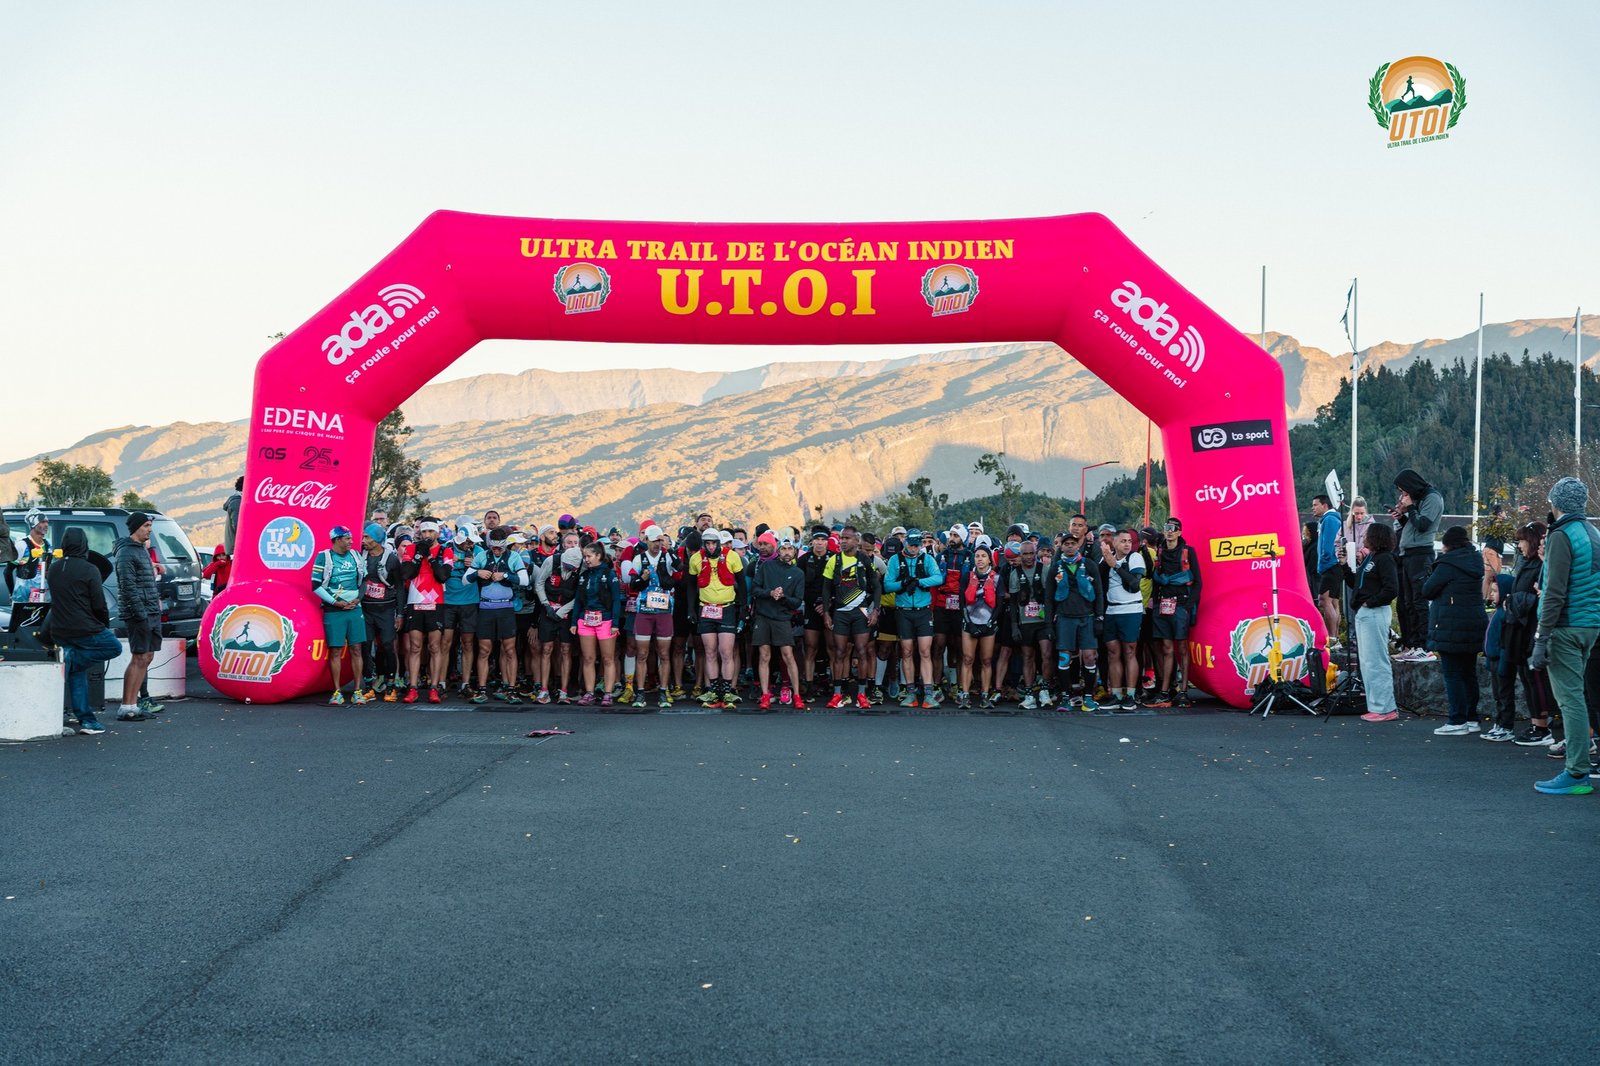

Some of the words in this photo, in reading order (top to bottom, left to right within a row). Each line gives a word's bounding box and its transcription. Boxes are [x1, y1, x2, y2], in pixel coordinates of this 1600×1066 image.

[520, 237, 618, 259] ULTRA
[627, 240, 718, 261] TRAIL
[726, 242, 765, 261] DE
[773, 237, 899, 262] L'OCÉAN
[908, 239, 1015, 260] INDIEN
[567, 291, 600, 311] UTOI
[656, 268, 877, 316] U.T.O.I
[934, 292, 969, 313] UTOI
[1110, 280, 1180, 347] ada
[321, 303, 395, 365] ada
[345, 369, 361, 384] ça
[360, 346, 391, 371] roule
[390, 325, 417, 350] pour
[417, 305, 440, 327] moi
[1093, 309, 1110, 324] ça
[1109, 322, 1138, 348] roule
[1136, 346, 1164, 369] pour
[1163, 368, 1187, 388] moi
[263, 407, 344, 433] EDENA
[1245, 429, 1270, 441] sport
[254, 476, 337, 509] Coca-Cola
[266, 541, 306, 558] BAN
[1216, 540, 1275, 557] Bodet
[220, 651, 275, 676] UTOI
